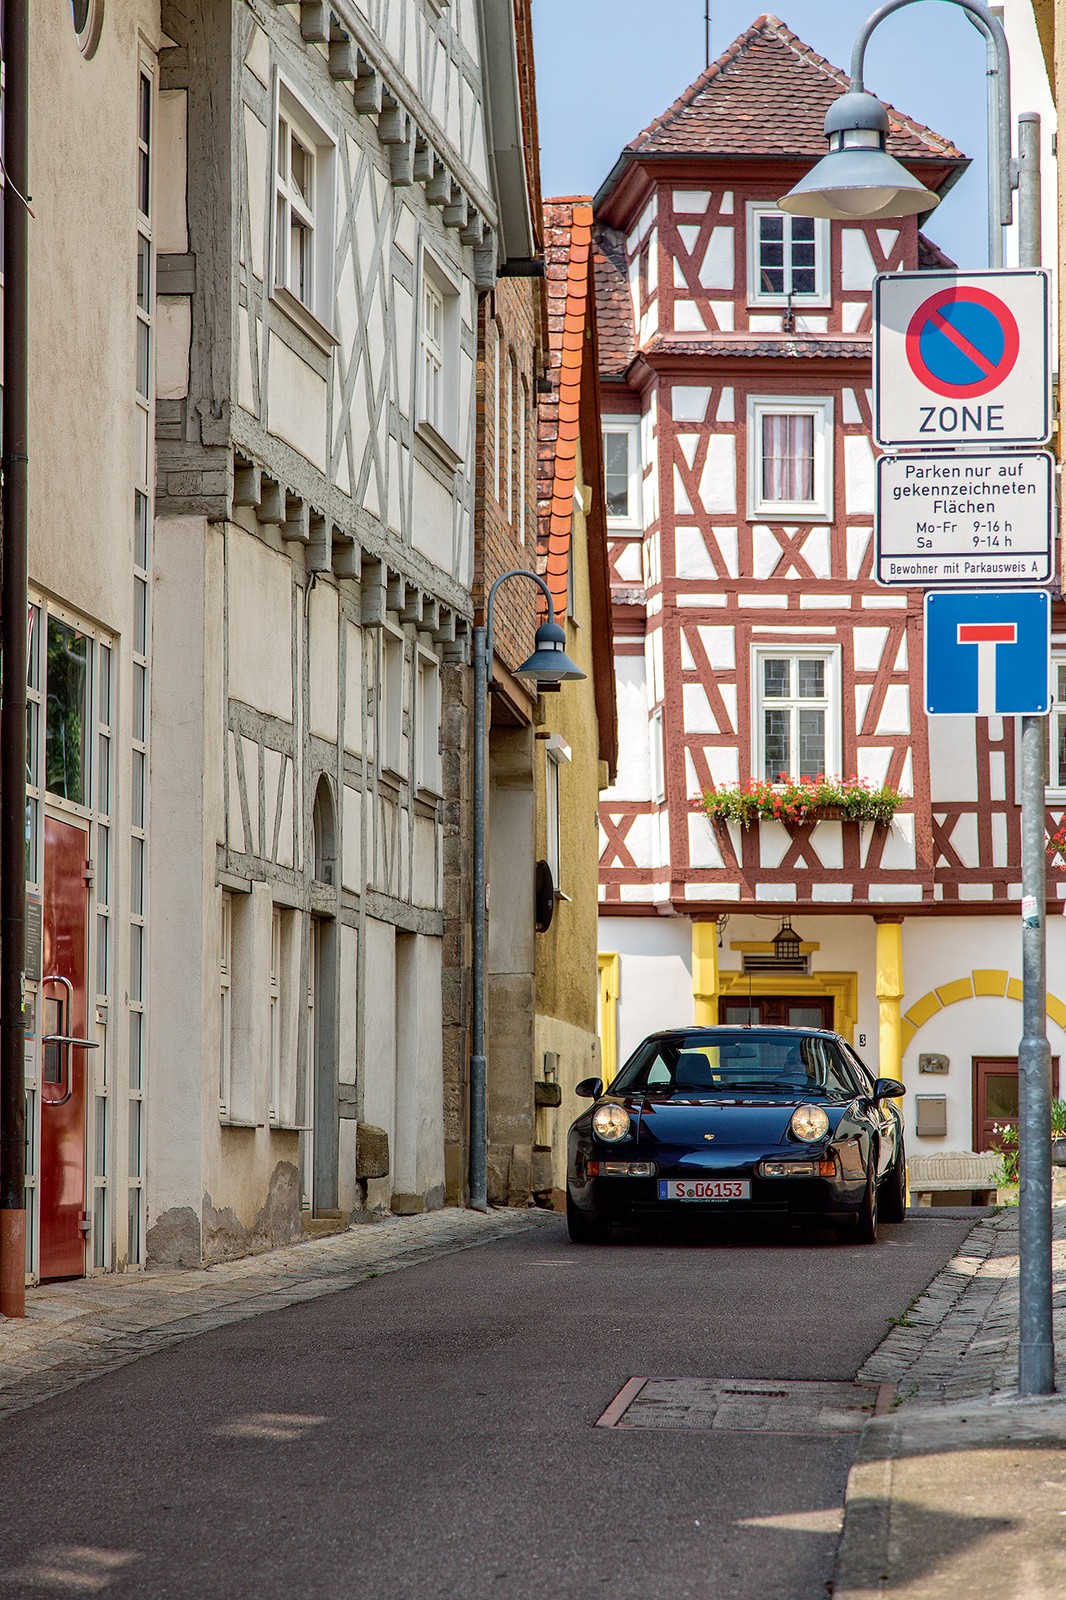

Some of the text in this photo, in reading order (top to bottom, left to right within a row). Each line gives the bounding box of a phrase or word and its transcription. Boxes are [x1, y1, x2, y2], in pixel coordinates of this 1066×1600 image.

[919, 405, 1005, 433] ZONE
[905, 463, 1024, 478] Parken nur auf
[893, 482, 1036, 500] gekennzeichneten
[933, 500, 995, 514] Flächen
[916, 520, 1012, 534] Mo-Fr 9-16 h
[916, 535, 1012, 549] Sa 9-14 h
[890, 561, 1038, 575] Bewohner mit Parkausweis A
[860, 1035, 866, 1046] 3
[675, 1182, 742, 1198] S 06153
